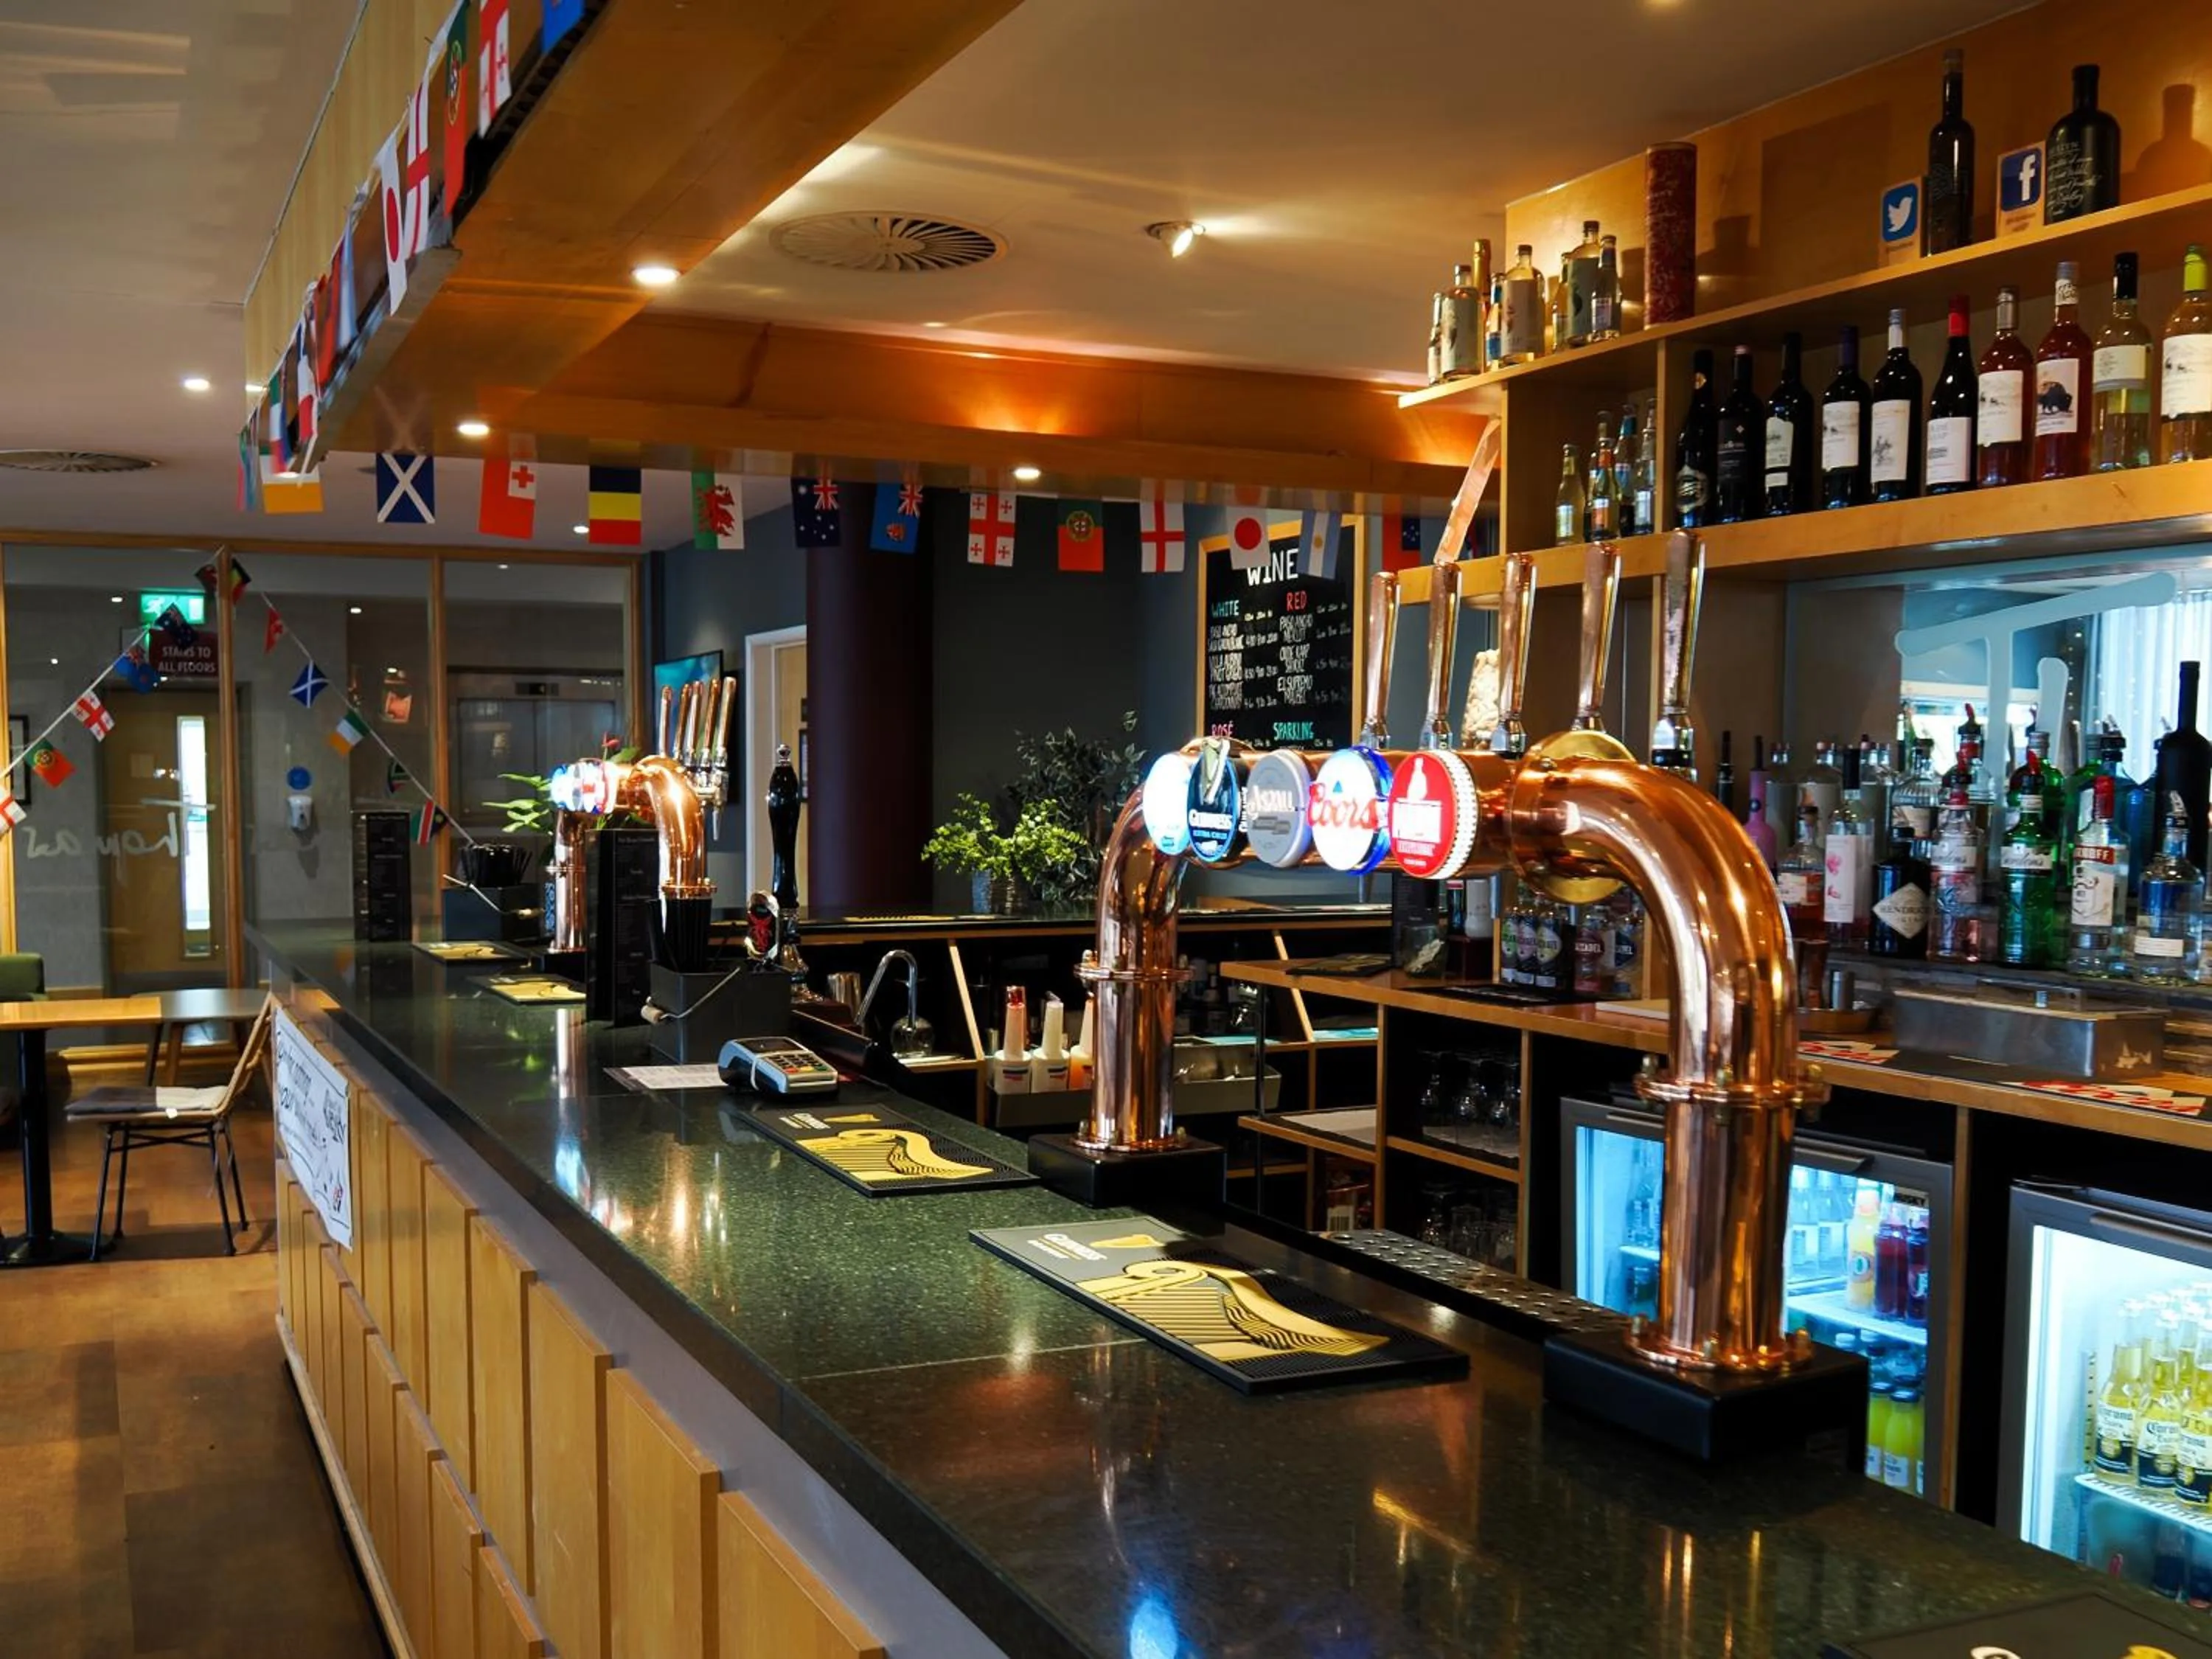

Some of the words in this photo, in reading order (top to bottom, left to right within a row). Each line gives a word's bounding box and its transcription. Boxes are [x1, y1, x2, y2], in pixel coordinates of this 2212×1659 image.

[2019, 153, 2035, 201] f
[1247, 548, 1299, 586] WINE
[1211, 599, 1239, 617] WHITE
[1286, 591, 1307, 611] RED
[162, 646, 195, 658] STAIRS
[198, 647, 211, 658] TO
[158, 661, 175, 672] ALL
[178, 661, 215, 672] FLOORS
[1273, 722, 1314, 741] SPARKLING
[1306, 782, 1378, 830] Coors
